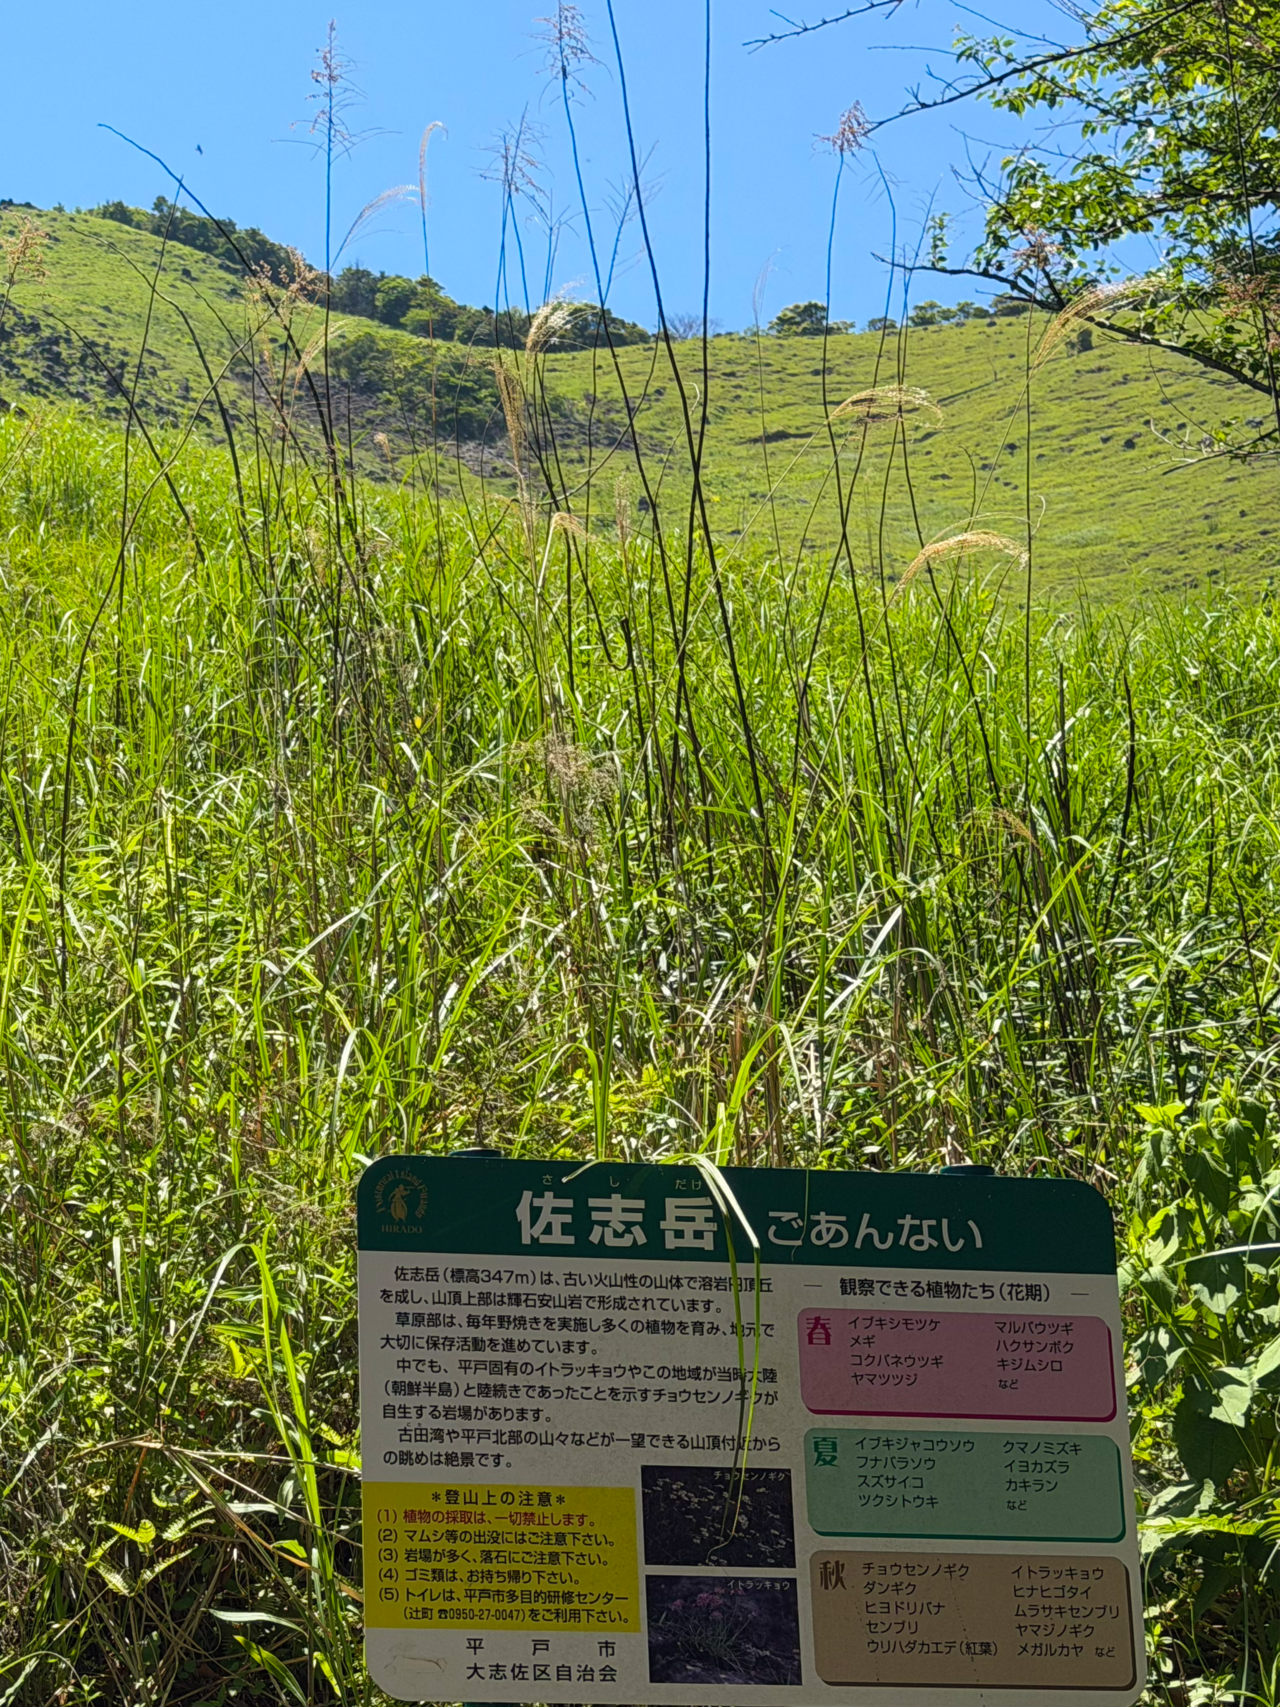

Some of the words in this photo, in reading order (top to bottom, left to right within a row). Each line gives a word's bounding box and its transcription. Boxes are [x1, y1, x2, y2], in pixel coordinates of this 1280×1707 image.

[382, 1224, 423, 1234] HIRADO
[516, 1190, 718, 1251] 佐志岳
[767, 1211, 983, 1252] ごあんない
[839, 1277, 1051, 1303] 観察できる植物たち（花期）
[380, 1289, 722, 1313] を成し、山頂上部は輝石安山岩で形成されています。
[805, 1316, 832, 1346] 春
[848, 1316, 941, 1333] イブキシモツケ
[994, 1320, 1073, 1336] マルバウツギ
[380, 1334, 597, 1355] 大切に保存活動を進めています。
[849, 1335, 876, 1348] メギ
[996, 1339, 1074, 1354] ハクサンボク
[850, 1353, 944, 1368] コクバネウツギ
[997, 1357, 1063, 1372] キジムシロ
[851, 1372, 918, 1387] ヤマツツジ
[998, 1378, 1019, 1390] など
[383, 1404, 551, 1423] 自生する岩場があります。
[812, 1436, 839, 1467] 夏
[854, 1437, 975, 1453] イブキジャコウソウ
[1002, 1440, 1082, 1456] クマノミズキ
[383, 1450, 512, 1468] の眺めは絶景です。
[856, 1456, 936, 1472] フナバラソウ
[1003, 1460, 1070, 1474] イヨカズラ
[857, 1475, 924, 1489] スズサイコ
[1005, 1478, 1058, 1493] カキラン
[858, 1493, 939, 1509] ツクシトウキ
[1006, 1499, 1027, 1511] など
[377, 1509, 396, 1525] (1)
[403, 1509, 595, 1527] 植物の採取は、一切禁止します。
[377, 1528, 398, 1544] (2)
[404, 1529, 614, 1547] マムシ等の出没にはご注意下さい。
[378, 1548, 398, 1563] (3)
[404, 1548, 608, 1566] 岩場が多く、落石にご注意下さい。
[379, 1568, 399, 1583] (4)
[405, 1568, 579, 1585] ゴミ類は、お持ち帰り下さい。
[819, 1560, 847, 1591] 秋
[861, 1562, 970, 1578] チョウセンノギク
[1011, 1565, 1104, 1581] イトラッキョウ
[727, 1580, 790, 1591] イトラッキョウ
[863, 1581, 917, 1596] ダンギク
[1013, 1585, 1092, 1600] ヒナヒゴタイ
[379, 1588, 399, 1603] (5)
[406, 1588, 628, 1606] トイレは、平戸市多目的研修センター
[864, 1601, 946, 1616] ヒヨドリバナ
[1014, 1604, 1120, 1620] ムラサキセンブリ
[866, 1620, 919, 1635] センブリ
[1015, 1623, 1095, 1639] ヤマジノギク
[866, 1639, 998, 1658] ウリハダカエデ（紅葉）
[1017, 1643, 1084, 1658] メガルカヤ
[1095, 1646, 1116, 1658] など
[466, 1663, 618, 1683] 大志佐区自治会
